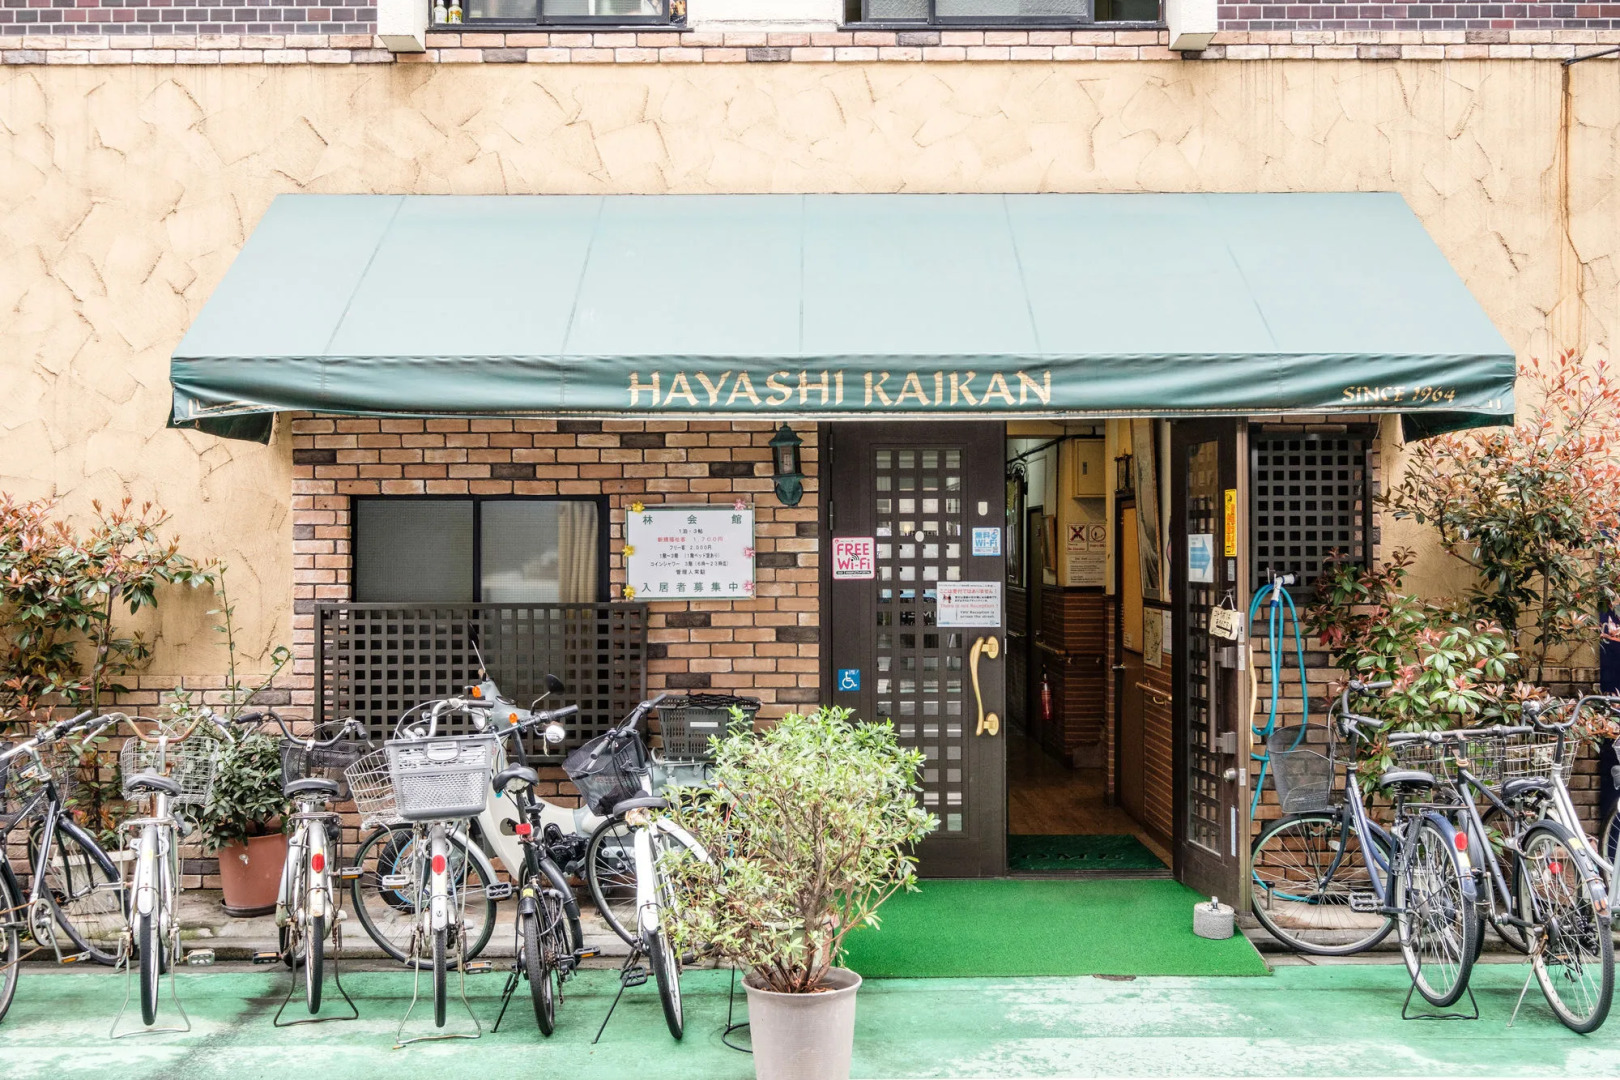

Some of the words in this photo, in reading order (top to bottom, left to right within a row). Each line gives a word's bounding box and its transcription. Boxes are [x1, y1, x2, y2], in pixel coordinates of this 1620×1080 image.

[628, 369, 844, 407] HAYASHI
[863, 369, 1052, 406] KAIKAN
[1341, 386, 1406, 403] SINCE
[1412, 386, 1456, 403] 1964
[642, 514, 743, 525] 林会館
[836, 543, 870, 556] FREE
[837, 557, 871, 570] Wi-Fi
[641, 581, 739, 593] 入居者募集中
